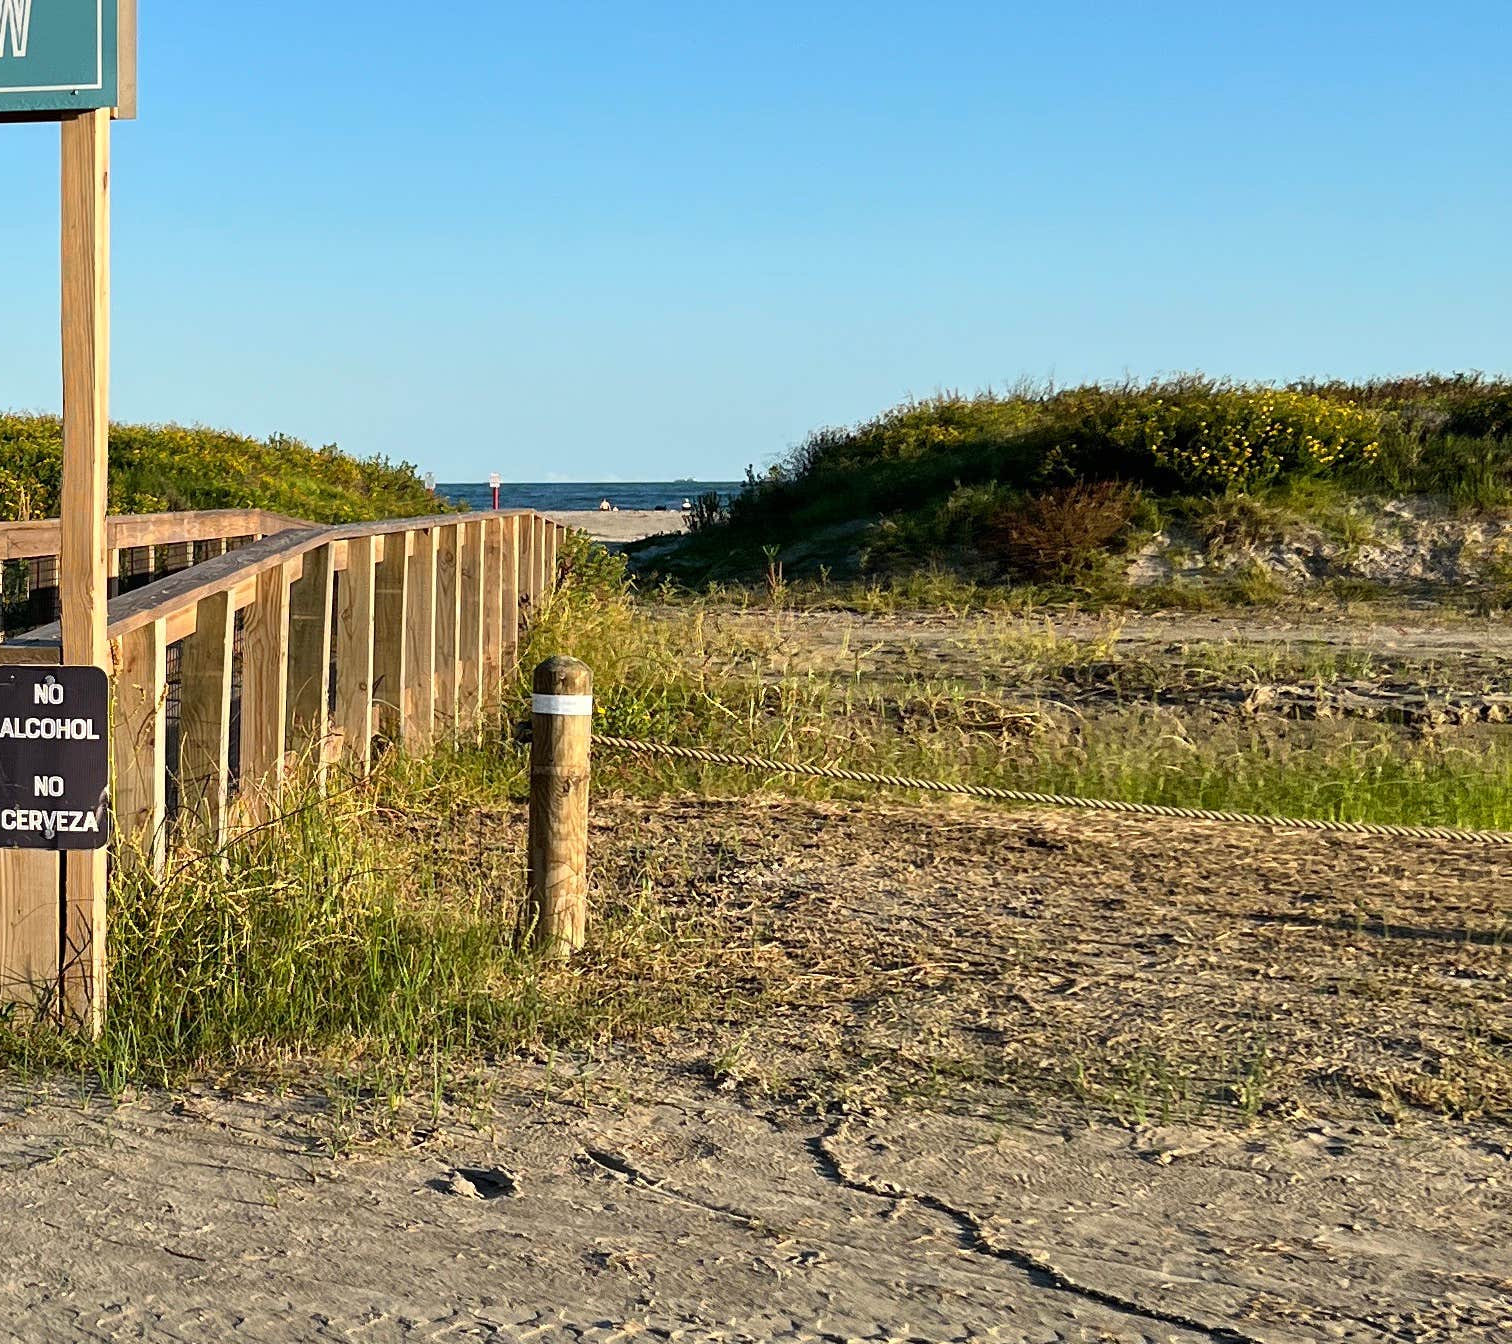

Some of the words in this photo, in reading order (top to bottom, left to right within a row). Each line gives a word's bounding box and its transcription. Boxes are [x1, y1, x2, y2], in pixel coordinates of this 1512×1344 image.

[34, 683, 64, 705] NO
[0, 717, 100, 740] ALCOHOL
[34, 775, 64, 797] NO
[1, 809, 100, 833] CERVEZA
